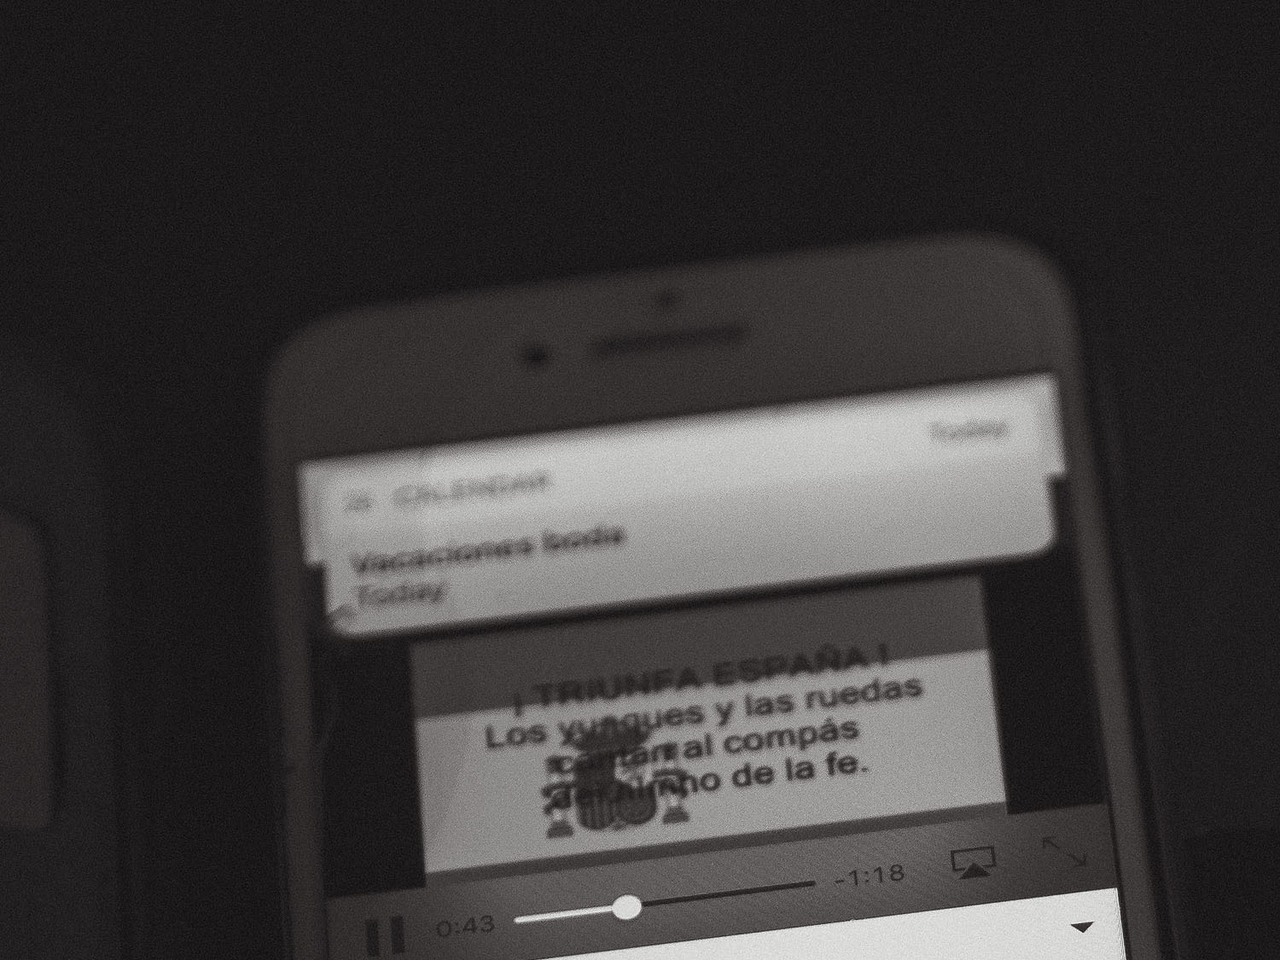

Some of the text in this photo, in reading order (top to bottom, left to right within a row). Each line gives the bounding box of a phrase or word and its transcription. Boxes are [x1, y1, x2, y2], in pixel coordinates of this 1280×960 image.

[352, 526, 627, 577] Vacaciones boda
[356, 581, 447, 606] Today
[534, 666, 699, 707] TRIUNFA
[712, 644, 868, 687] ESPAÑA
[485, 722, 548, 749] Los
[716, 701, 734, 727] y
[744, 693, 795, 718] las
[805, 676, 923, 709] ruedas
[683, 733, 713, 760] al
[723, 717, 860, 752] compás
[732, 762, 775, 789] de
[785, 757, 815, 782] la
[825, 750, 869, 777] fe.
[436, 863, 906, 938] 0:43 -1:18
